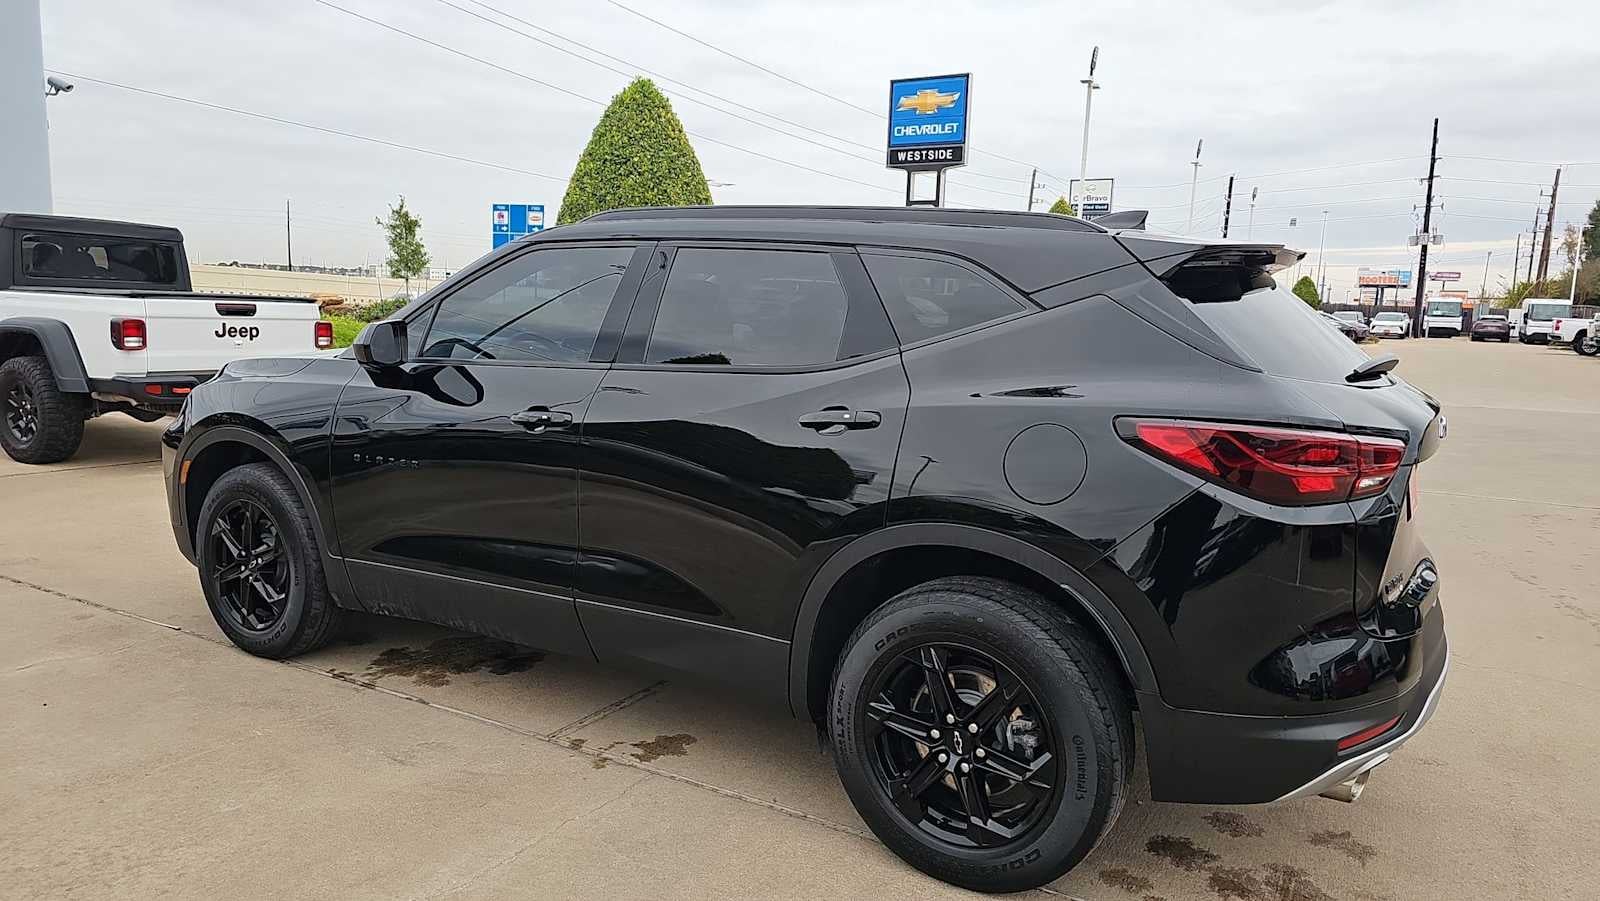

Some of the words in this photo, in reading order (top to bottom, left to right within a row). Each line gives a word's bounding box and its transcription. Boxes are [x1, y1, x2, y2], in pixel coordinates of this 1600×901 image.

[894, 123, 960, 137] CHEVROLET
[897, 149, 953, 162] WESTSIDE
[1073, 194, 1108, 202] CrBravo
[214, 322, 260, 341] Jeep
